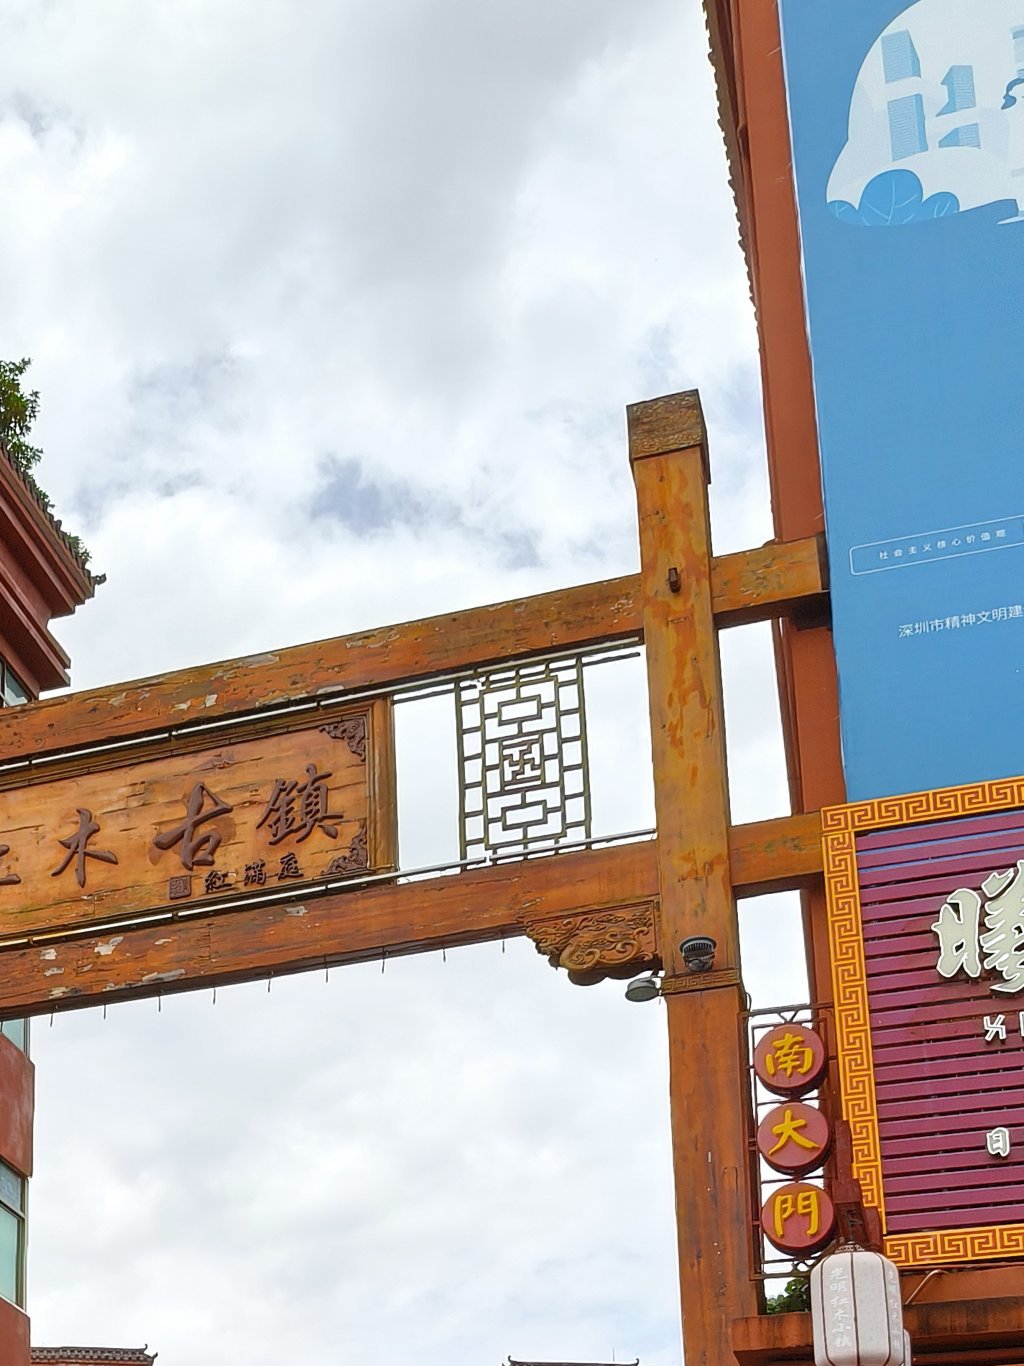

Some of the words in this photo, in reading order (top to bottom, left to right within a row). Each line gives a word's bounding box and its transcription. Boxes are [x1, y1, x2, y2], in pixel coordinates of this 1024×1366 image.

[879, 529, 1006, 560] 社会主义核心价值观
[898, 604, 1024, 638] 深圳市精神文明建
